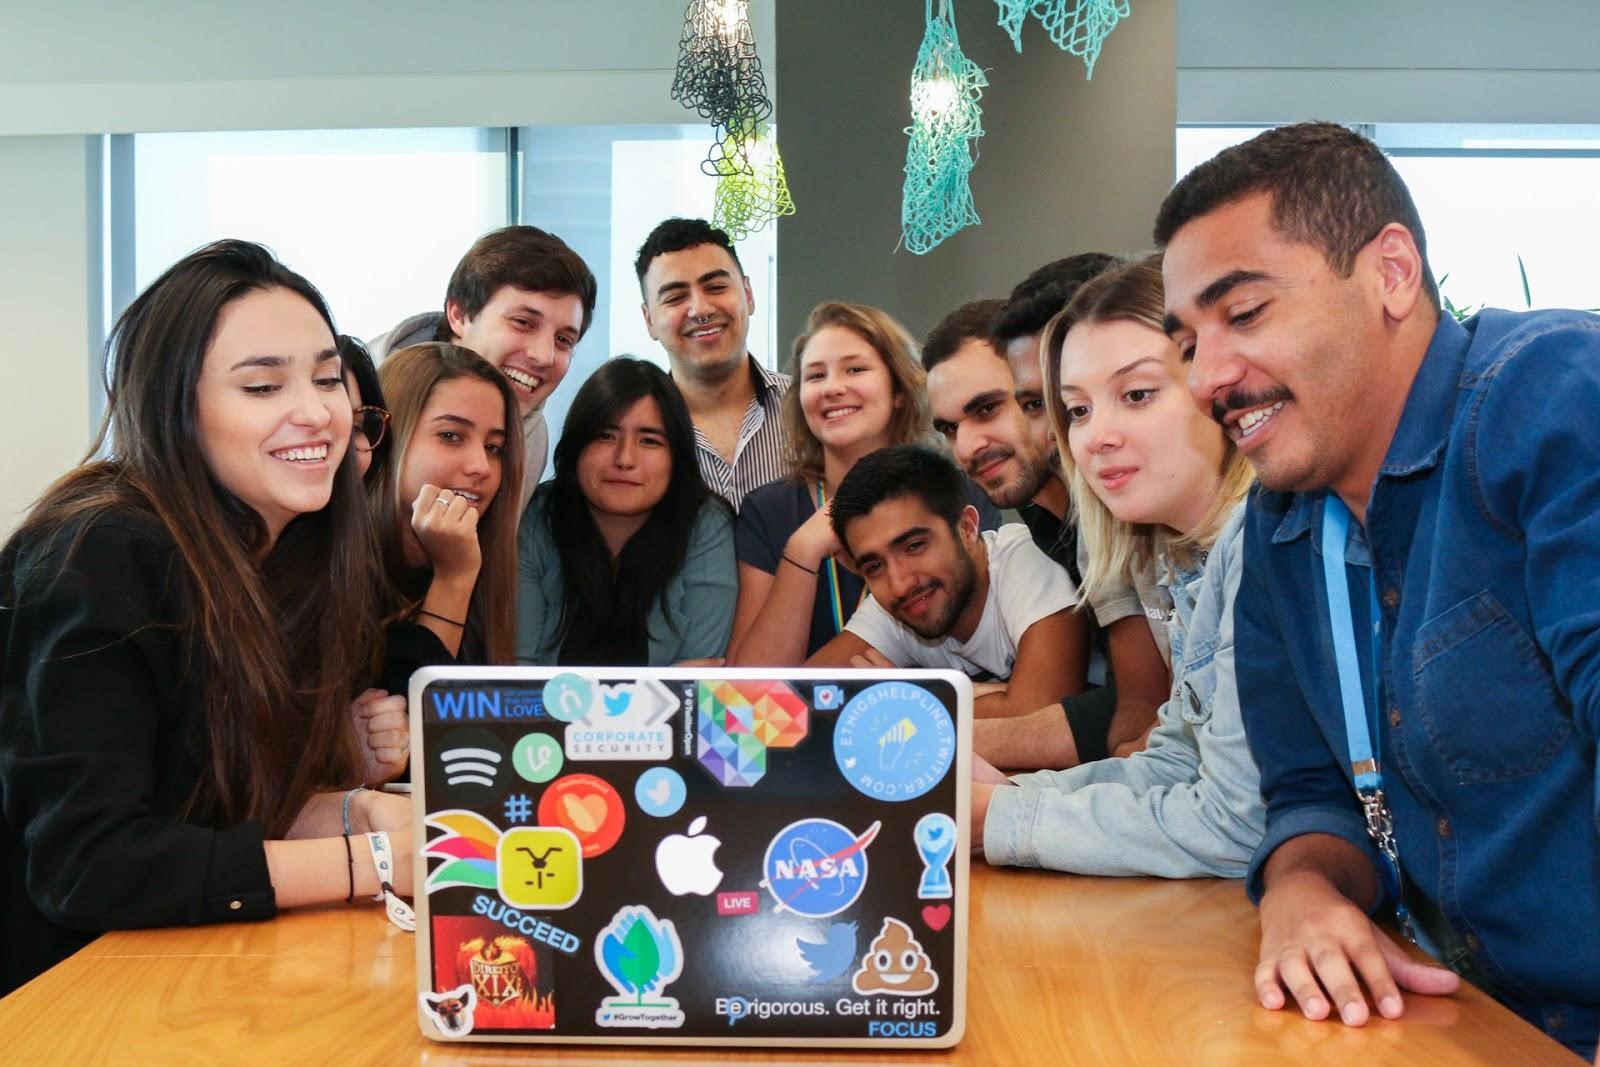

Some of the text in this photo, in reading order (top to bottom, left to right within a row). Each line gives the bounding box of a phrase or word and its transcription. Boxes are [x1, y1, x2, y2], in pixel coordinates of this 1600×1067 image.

[432, 690, 501, 719] WIN
[573, 731, 664, 742] CORPORATE
[573, 744, 665, 753] SECURITY
[775, 859, 859, 880] NASA
[724, 898, 751, 909] LIVE
[472, 894, 580, 954] SUCCEED
[747, 998, 830, 1019] rigorous.
[836, 998, 870, 1015] Get
[876, 998, 888, 1015] it
[893, 998, 941, 1019] right.
[614, 1012, 677, 1024] #GrowTogether
[868, 1021, 937, 1037] FOCUS
